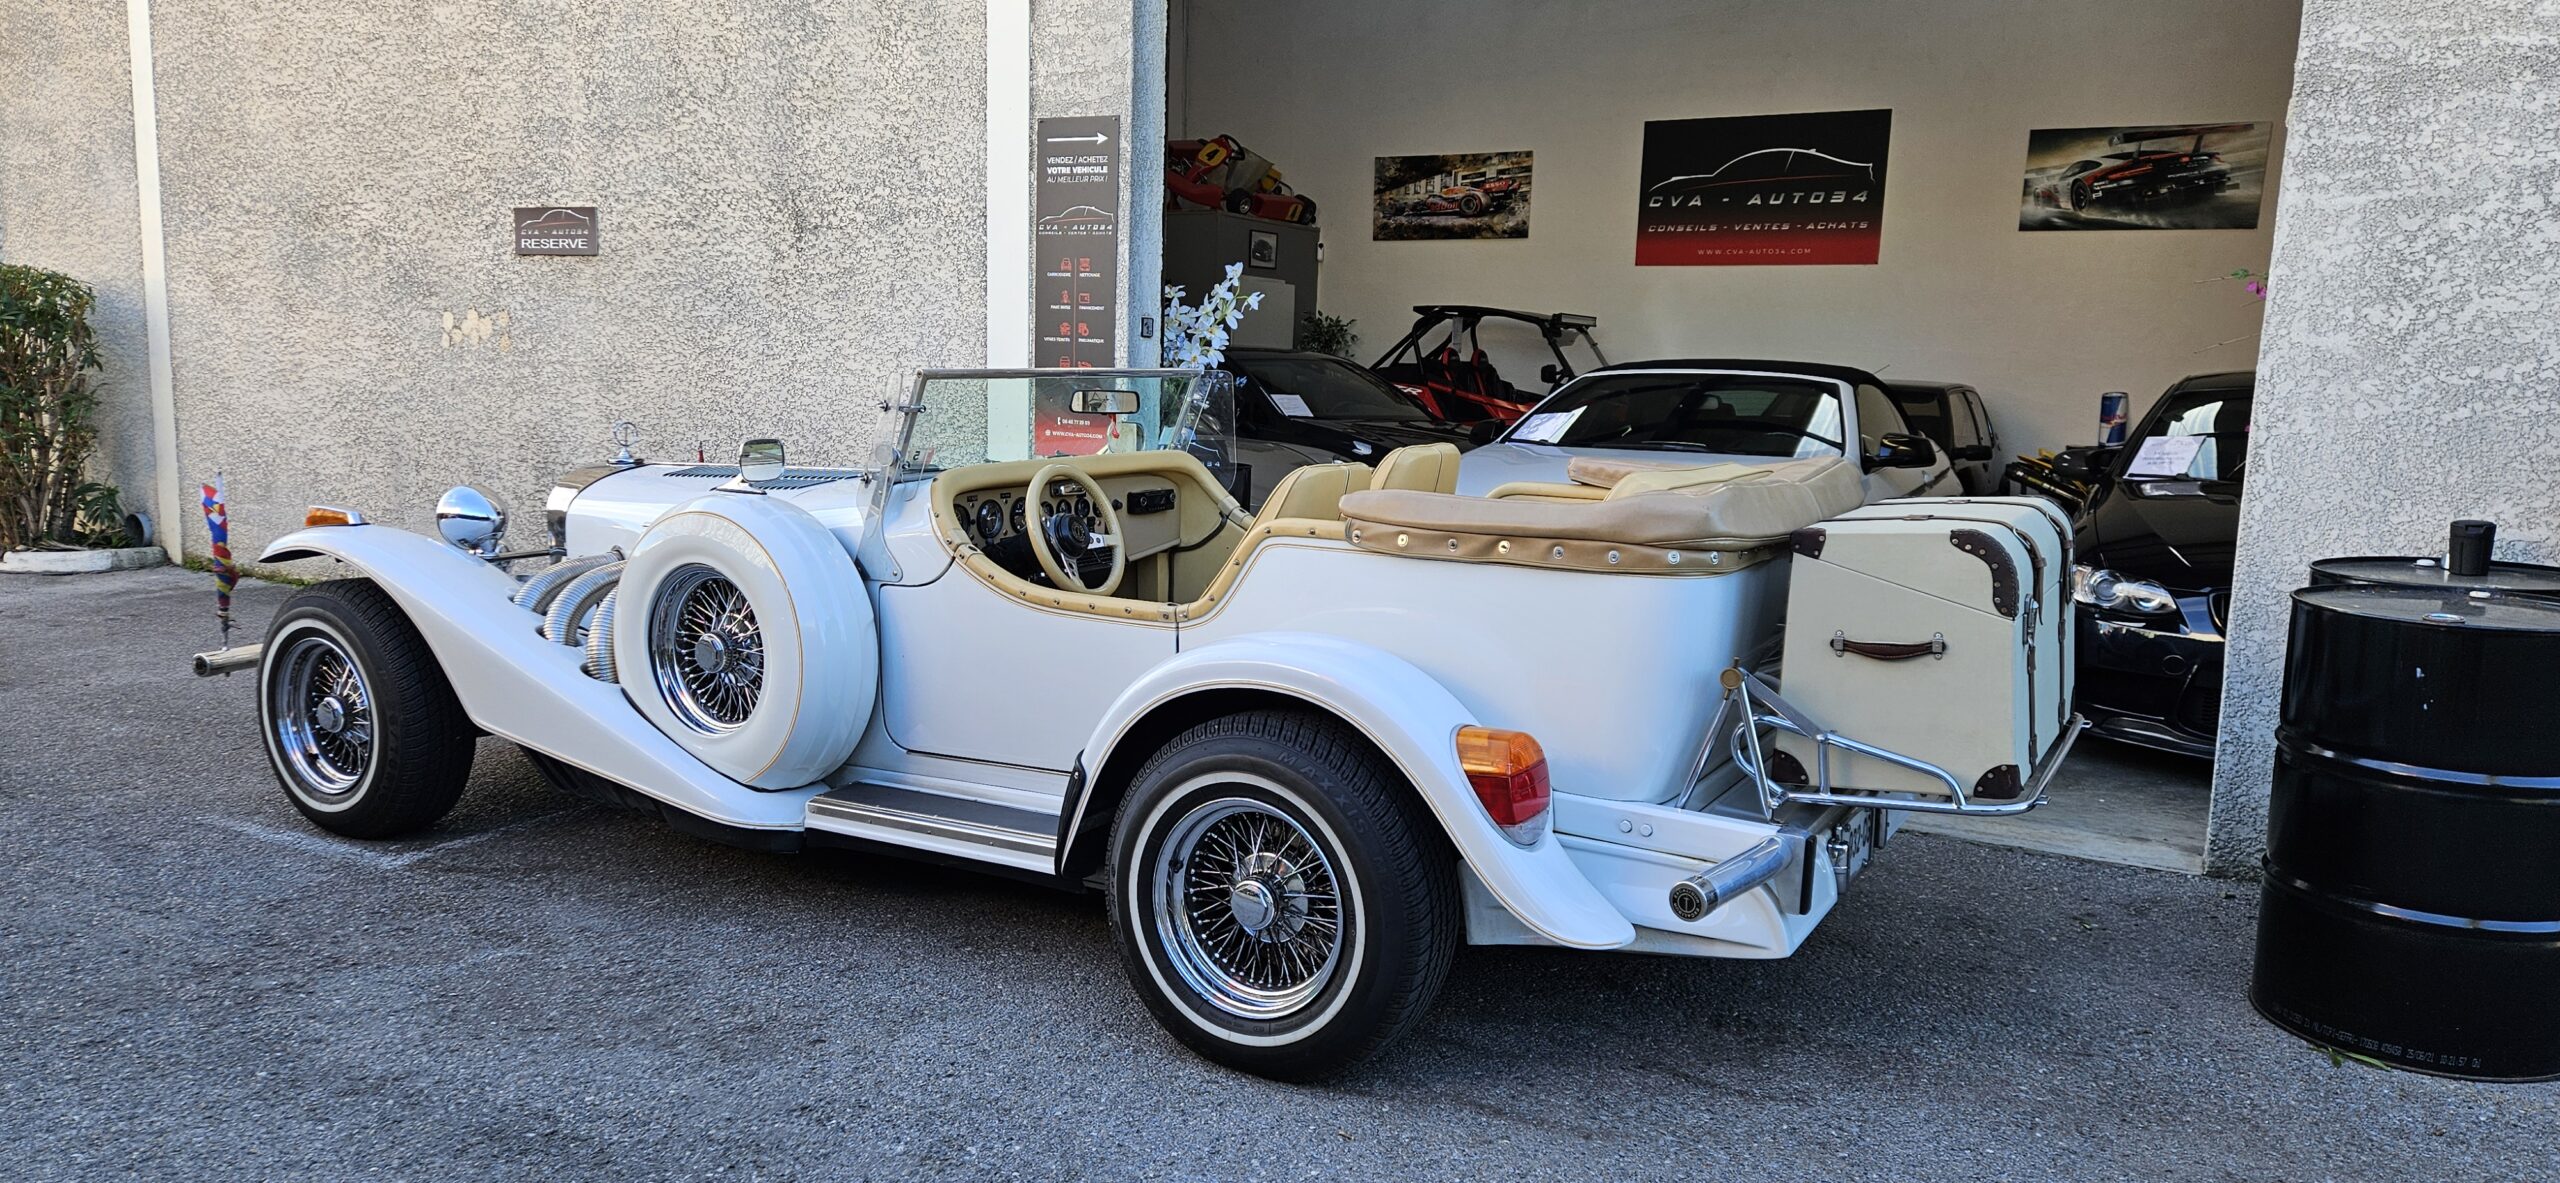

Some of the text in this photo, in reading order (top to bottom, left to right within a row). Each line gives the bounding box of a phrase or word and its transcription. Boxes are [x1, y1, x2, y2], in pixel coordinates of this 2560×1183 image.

[1046, 156, 1074, 164] VENDEZ
[1077, 155, 1109, 163] ACHETEZ
[1046, 165, 1109, 174] VOTRE VEHICULE
[1046, 176, 1057, 184] AU
[1056, 175, 1090, 183] MEILLEUR
[1089, 175, 1105, 183] PRIX
[1649, 194, 1703, 208] CVA
[1747, 190, 1869, 206] AUTO34
[1648, 224, 1718, 232] CONSEILS
[1734, 222, 1791, 231] VENTES
[1806, 221, 1870, 230] ACHATS
[521, 238, 588, 249] RESERVE
[1277, 751, 1370, 835] MAXXIS
